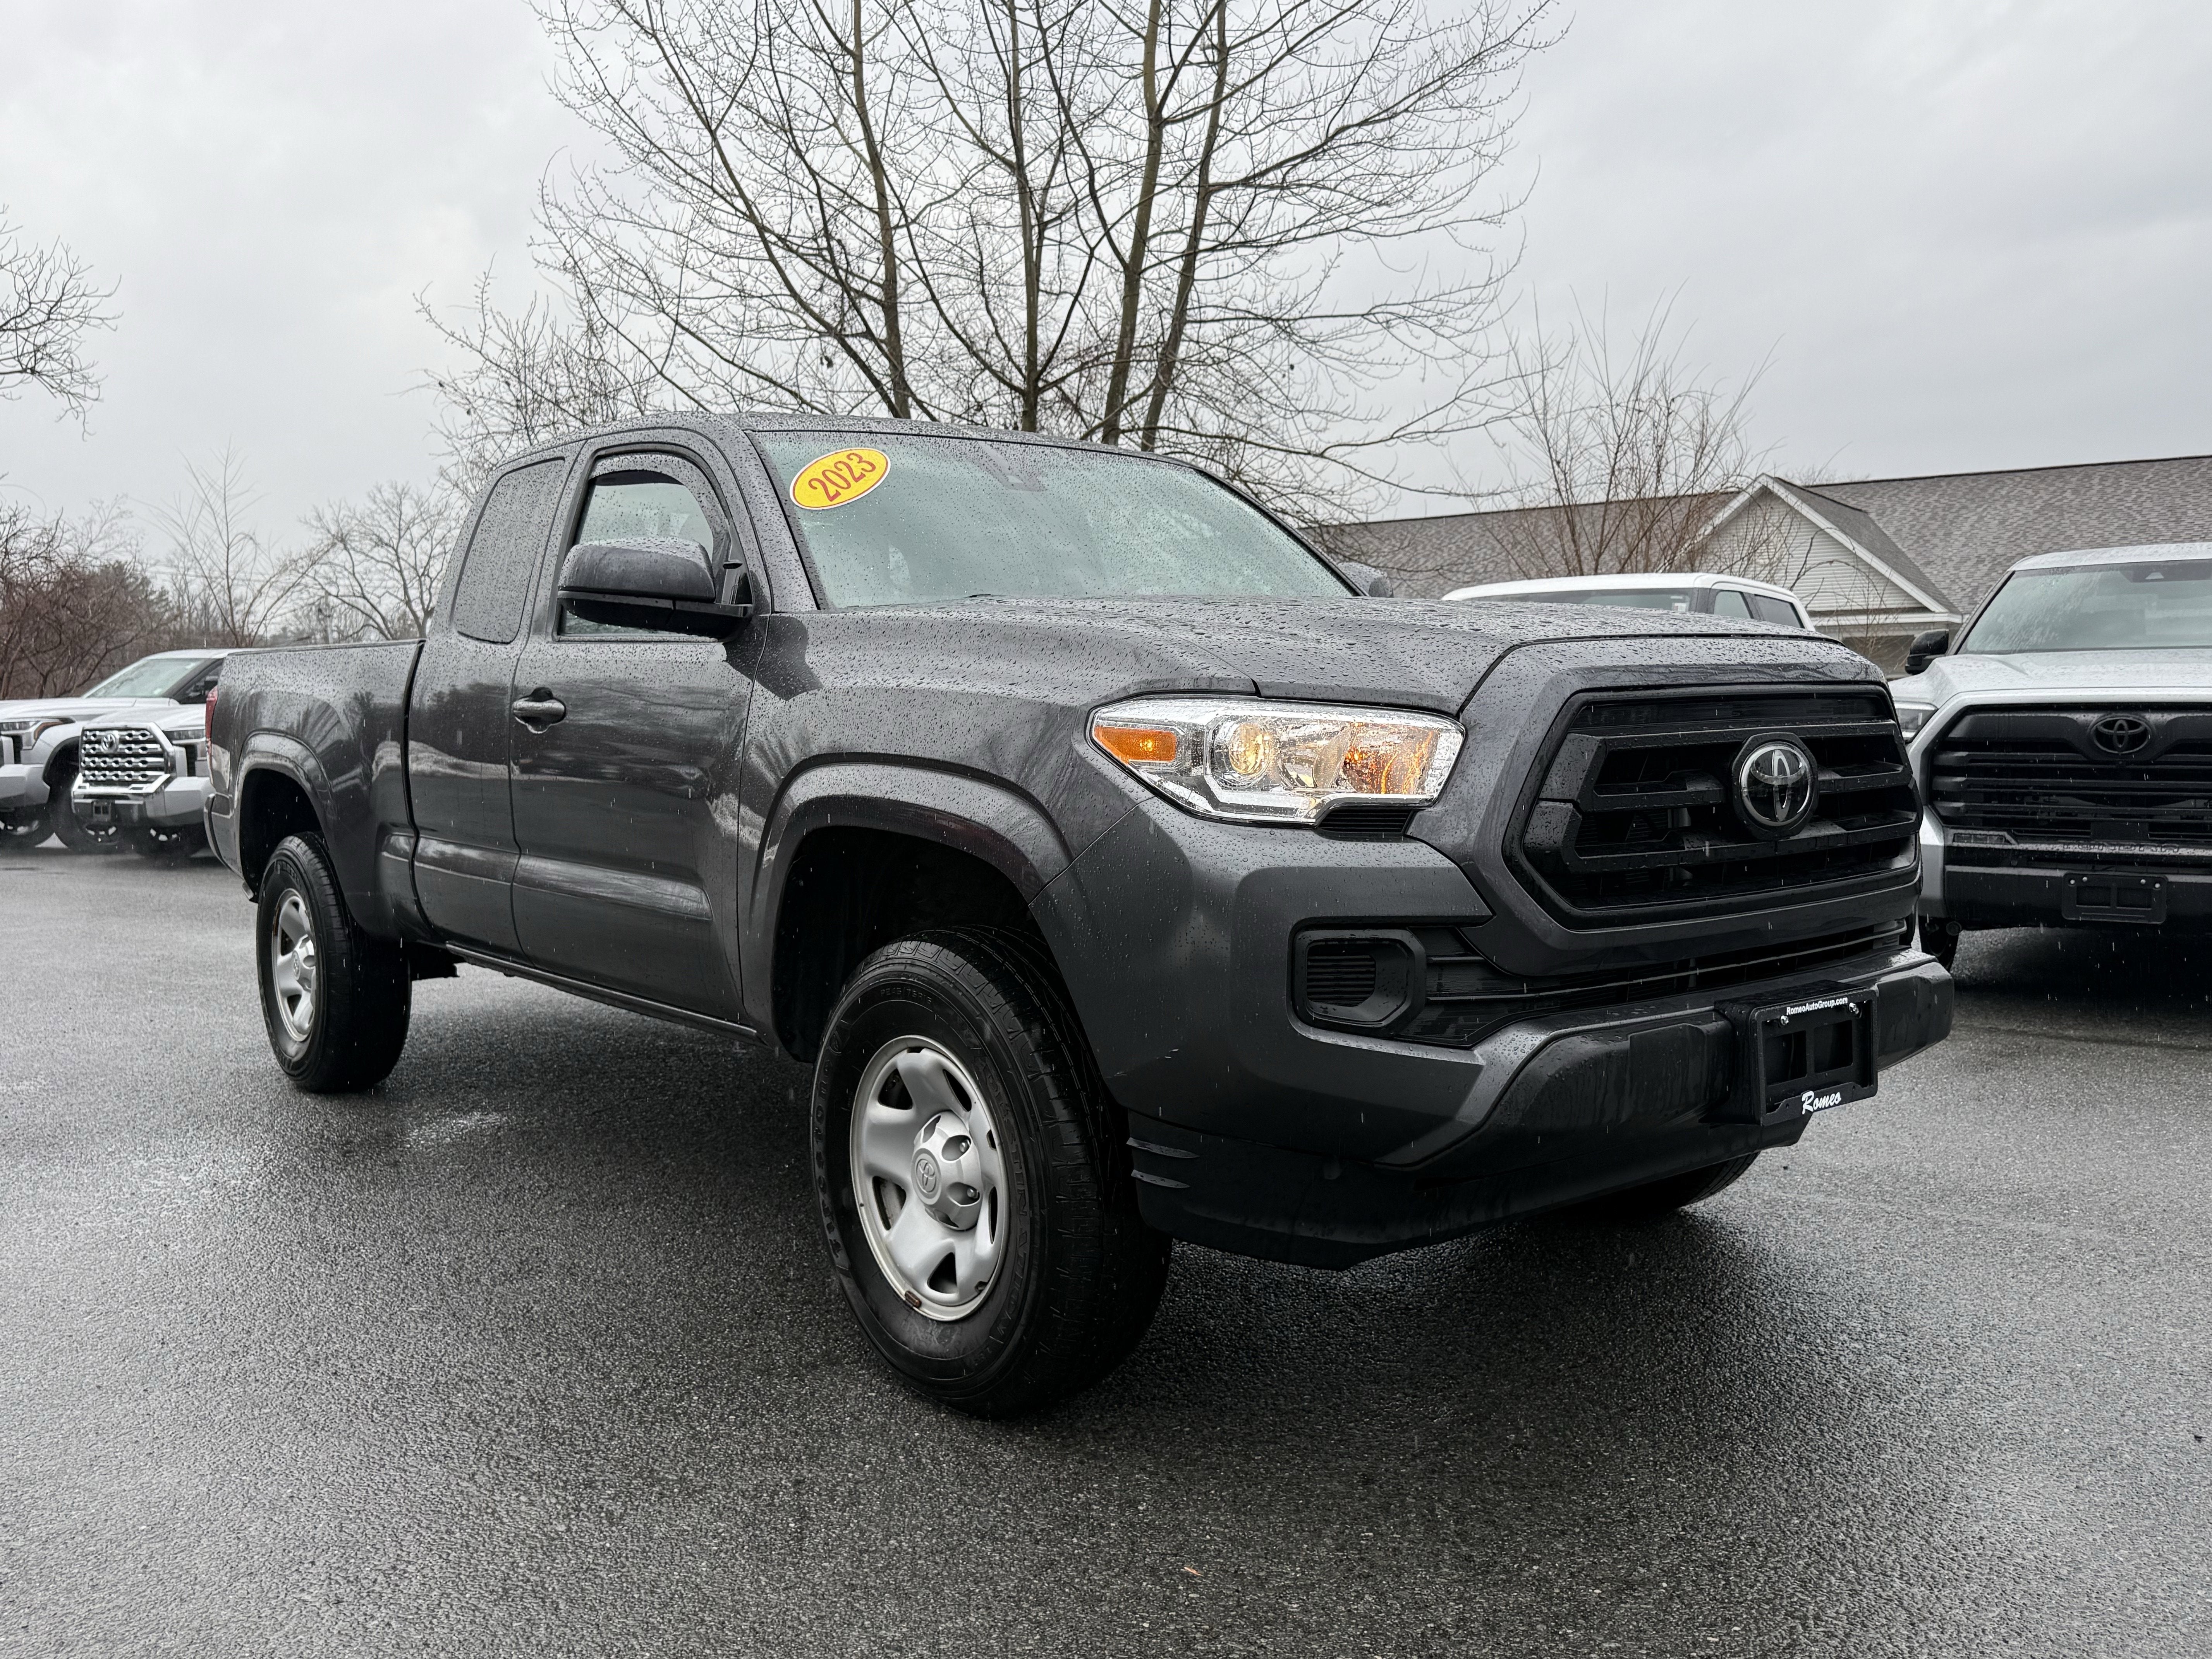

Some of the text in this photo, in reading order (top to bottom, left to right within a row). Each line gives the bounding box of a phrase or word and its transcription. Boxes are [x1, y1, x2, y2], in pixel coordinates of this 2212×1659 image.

[808, 452, 876, 501] 2023
[1786, 997, 1848, 1015] RomeoAutoGroup.com
[1802, 1091, 1841, 1115] Romeo
